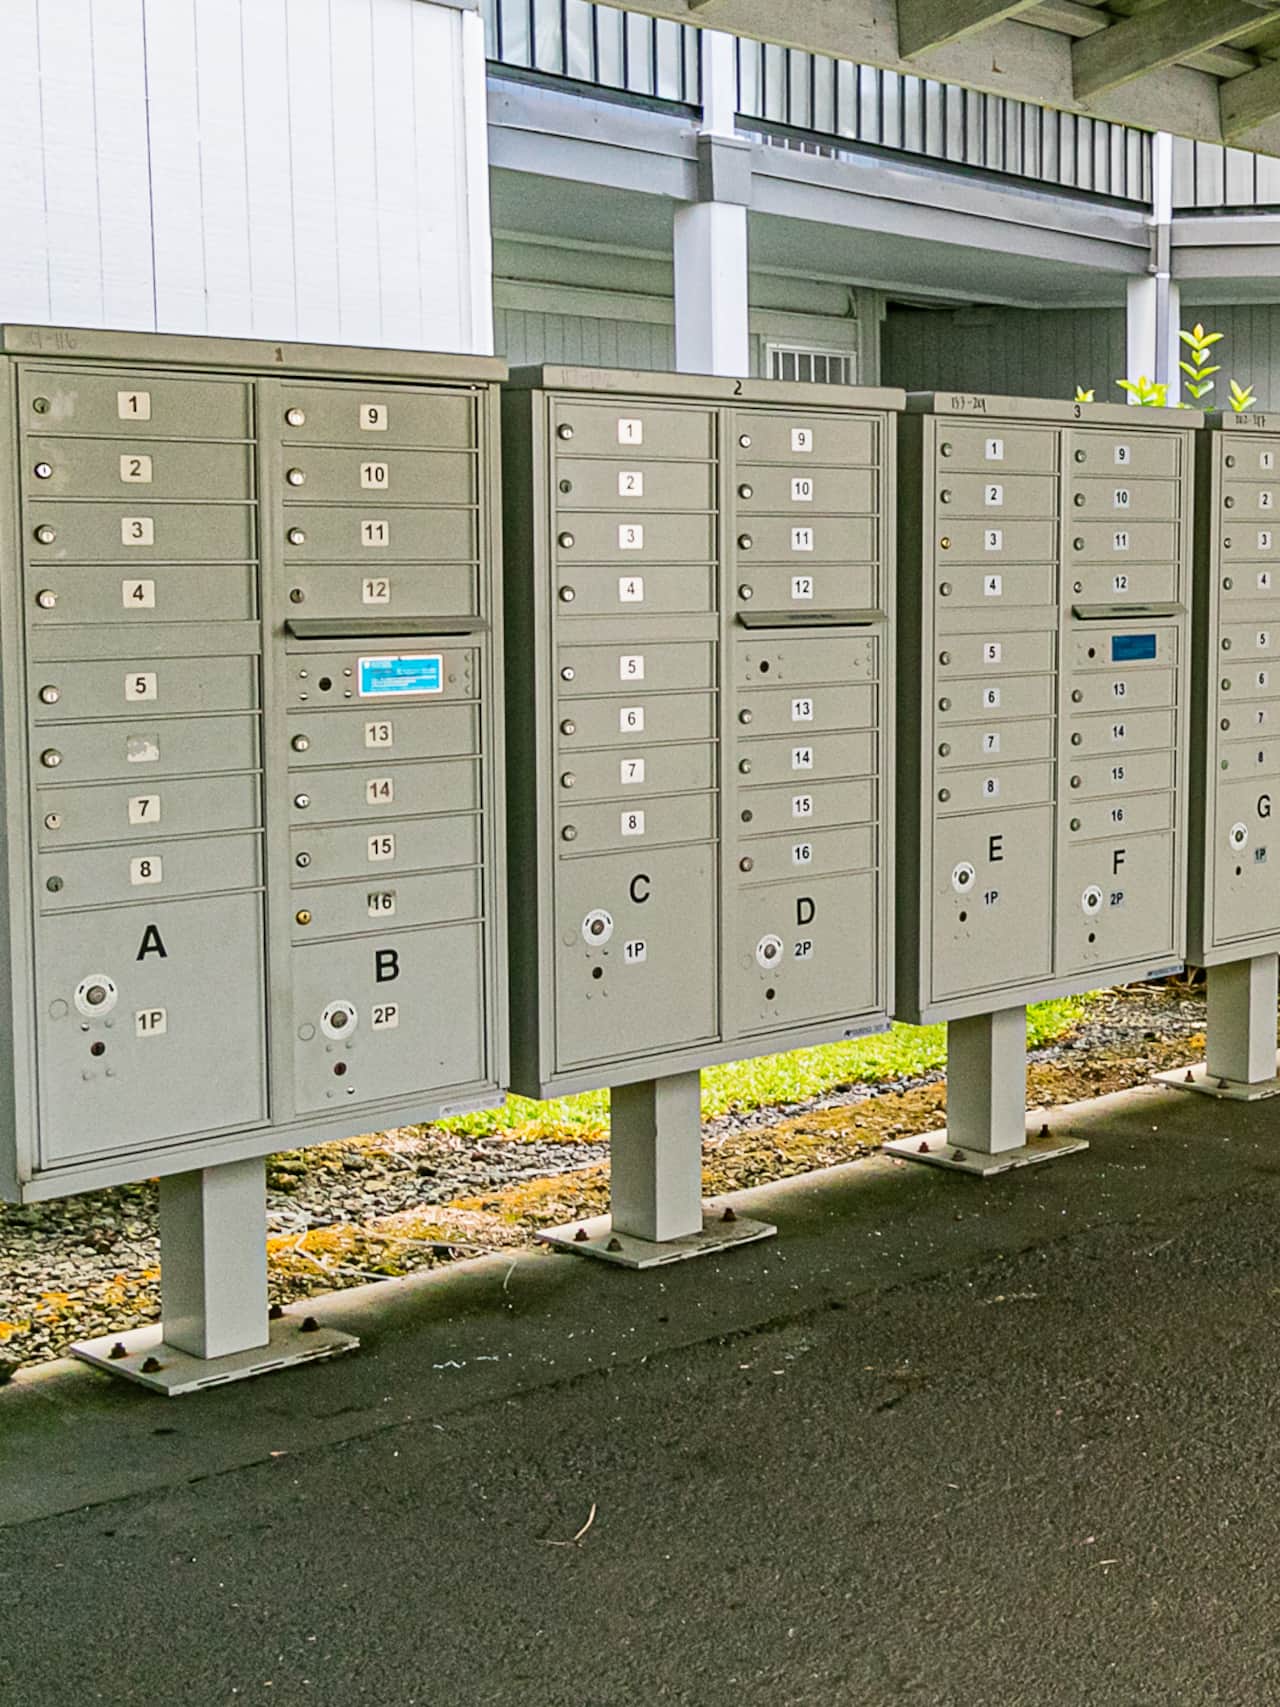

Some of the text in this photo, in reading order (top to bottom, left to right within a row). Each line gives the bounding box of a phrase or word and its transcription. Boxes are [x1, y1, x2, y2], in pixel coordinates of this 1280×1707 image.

[274, 347, 285, 362] 1
[733, 380, 743, 396] 2
[128, 395, 138, 413] 1
[1074, 404, 1081, 419] 3
[368, 408, 378, 424] 9
[626, 423, 633, 437] 1
[798, 432, 806, 446] 9
[991, 442, 998, 455] 1
[1118, 447, 1126, 461] 9
[130, 459, 141, 477] 2
[365, 466, 385, 482] 10
[626, 475, 635, 490] 2
[795, 481, 810, 496] 10
[990, 487, 997, 501] 2
[1116, 491, 1128, 504] 10
[1262, 493, 1268, 505] 2
[132, 521, 143, 539] 3
[365, 524, 383, 540] 11
[627, 528, 635, 543] 3
[795, 531, 808, 545] 11
[990, 532, 997, 546] 3
[1115, 534, 1126, 546] 11
[1262, 533, 1267, 546] 3
[366, 581, 386, 597] 12
[627, 581, 635, 595] 4
[795, 580, 810, 593] 12
[989, 578, 996, 590] 4
[1115, 576, 1127, 589] 12
[132, 584, 144, 601] 4
[1260, 633, 1266, 645] 5
[989, 645, 996, 659] 5
[628, 659, 636, 674] 5
[135, 677, 147, 694] 5
[1258, 672, 1265, 685] 6
[988, 690, 996, 704] 6
[1114, 683, 1125, 696] 13
[795, 701, 810, 715] 13
[627, 711, 636, 726] 6
[1258, 711, 1264, 724] 7
[369, 725, 389, 742] 13
[1113, 725, 1124, 737] 14
[988, 735, 994, 748] 7
[796, 750, 810, 763] 14
[1258, 751, 1264, 763] 8
[628, 763, 636, 777] 7
[1112, 767, 1124, 780] 15
[370, 781, 390, 798] 14
[987, 779, 994, 793] 8
[138, 799, 150, 817] 7
[795, 798, 810, 812] 15
[1257, 794, 1271, 818] G
[628, 815, 637, 830] 8
[1111, 808, 1123, 822] 16
[371, 838, 392, 855] 15
[795, 845, 810, 860] 16
[989, 835, 1003, 862] E
[140, 860, 152, 878] 8
[1113, 849, 1126, 875] F
[629, 874, 650, 904] C
[984, 891, 998, 905] 1P
[1110, 892, 1124, 906] 2P
[796, 897, 815, 926] D
[136, 924, 168, 961] A
[626, 941, 645, 959] 1P
[795, 941, 812, 957] 2P
[375, 949, 400, 983] B
[138, 1011, 162, 1030] 1P
[374, 1006, 396, 1025] 2P
